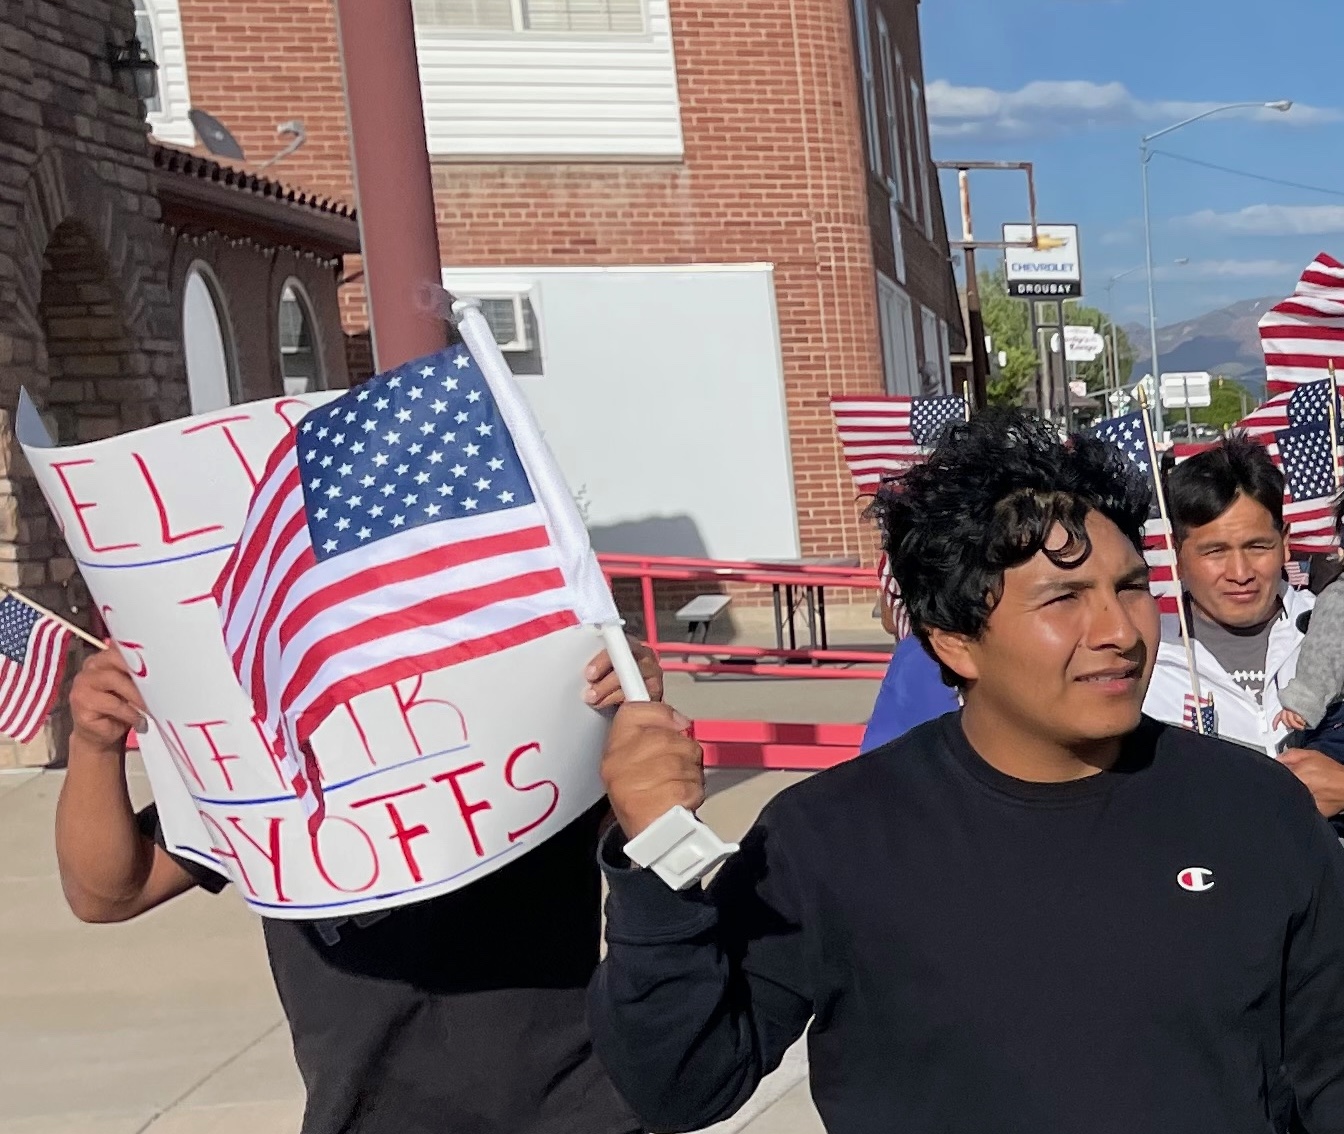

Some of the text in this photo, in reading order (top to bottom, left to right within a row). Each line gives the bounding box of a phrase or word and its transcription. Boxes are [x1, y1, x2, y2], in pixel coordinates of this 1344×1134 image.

[1012, 263, 1074, 272] CHEVROLET
[1017, 283, 1071, 294] DROUBAY
[42, 398, 312, 553] ELT
